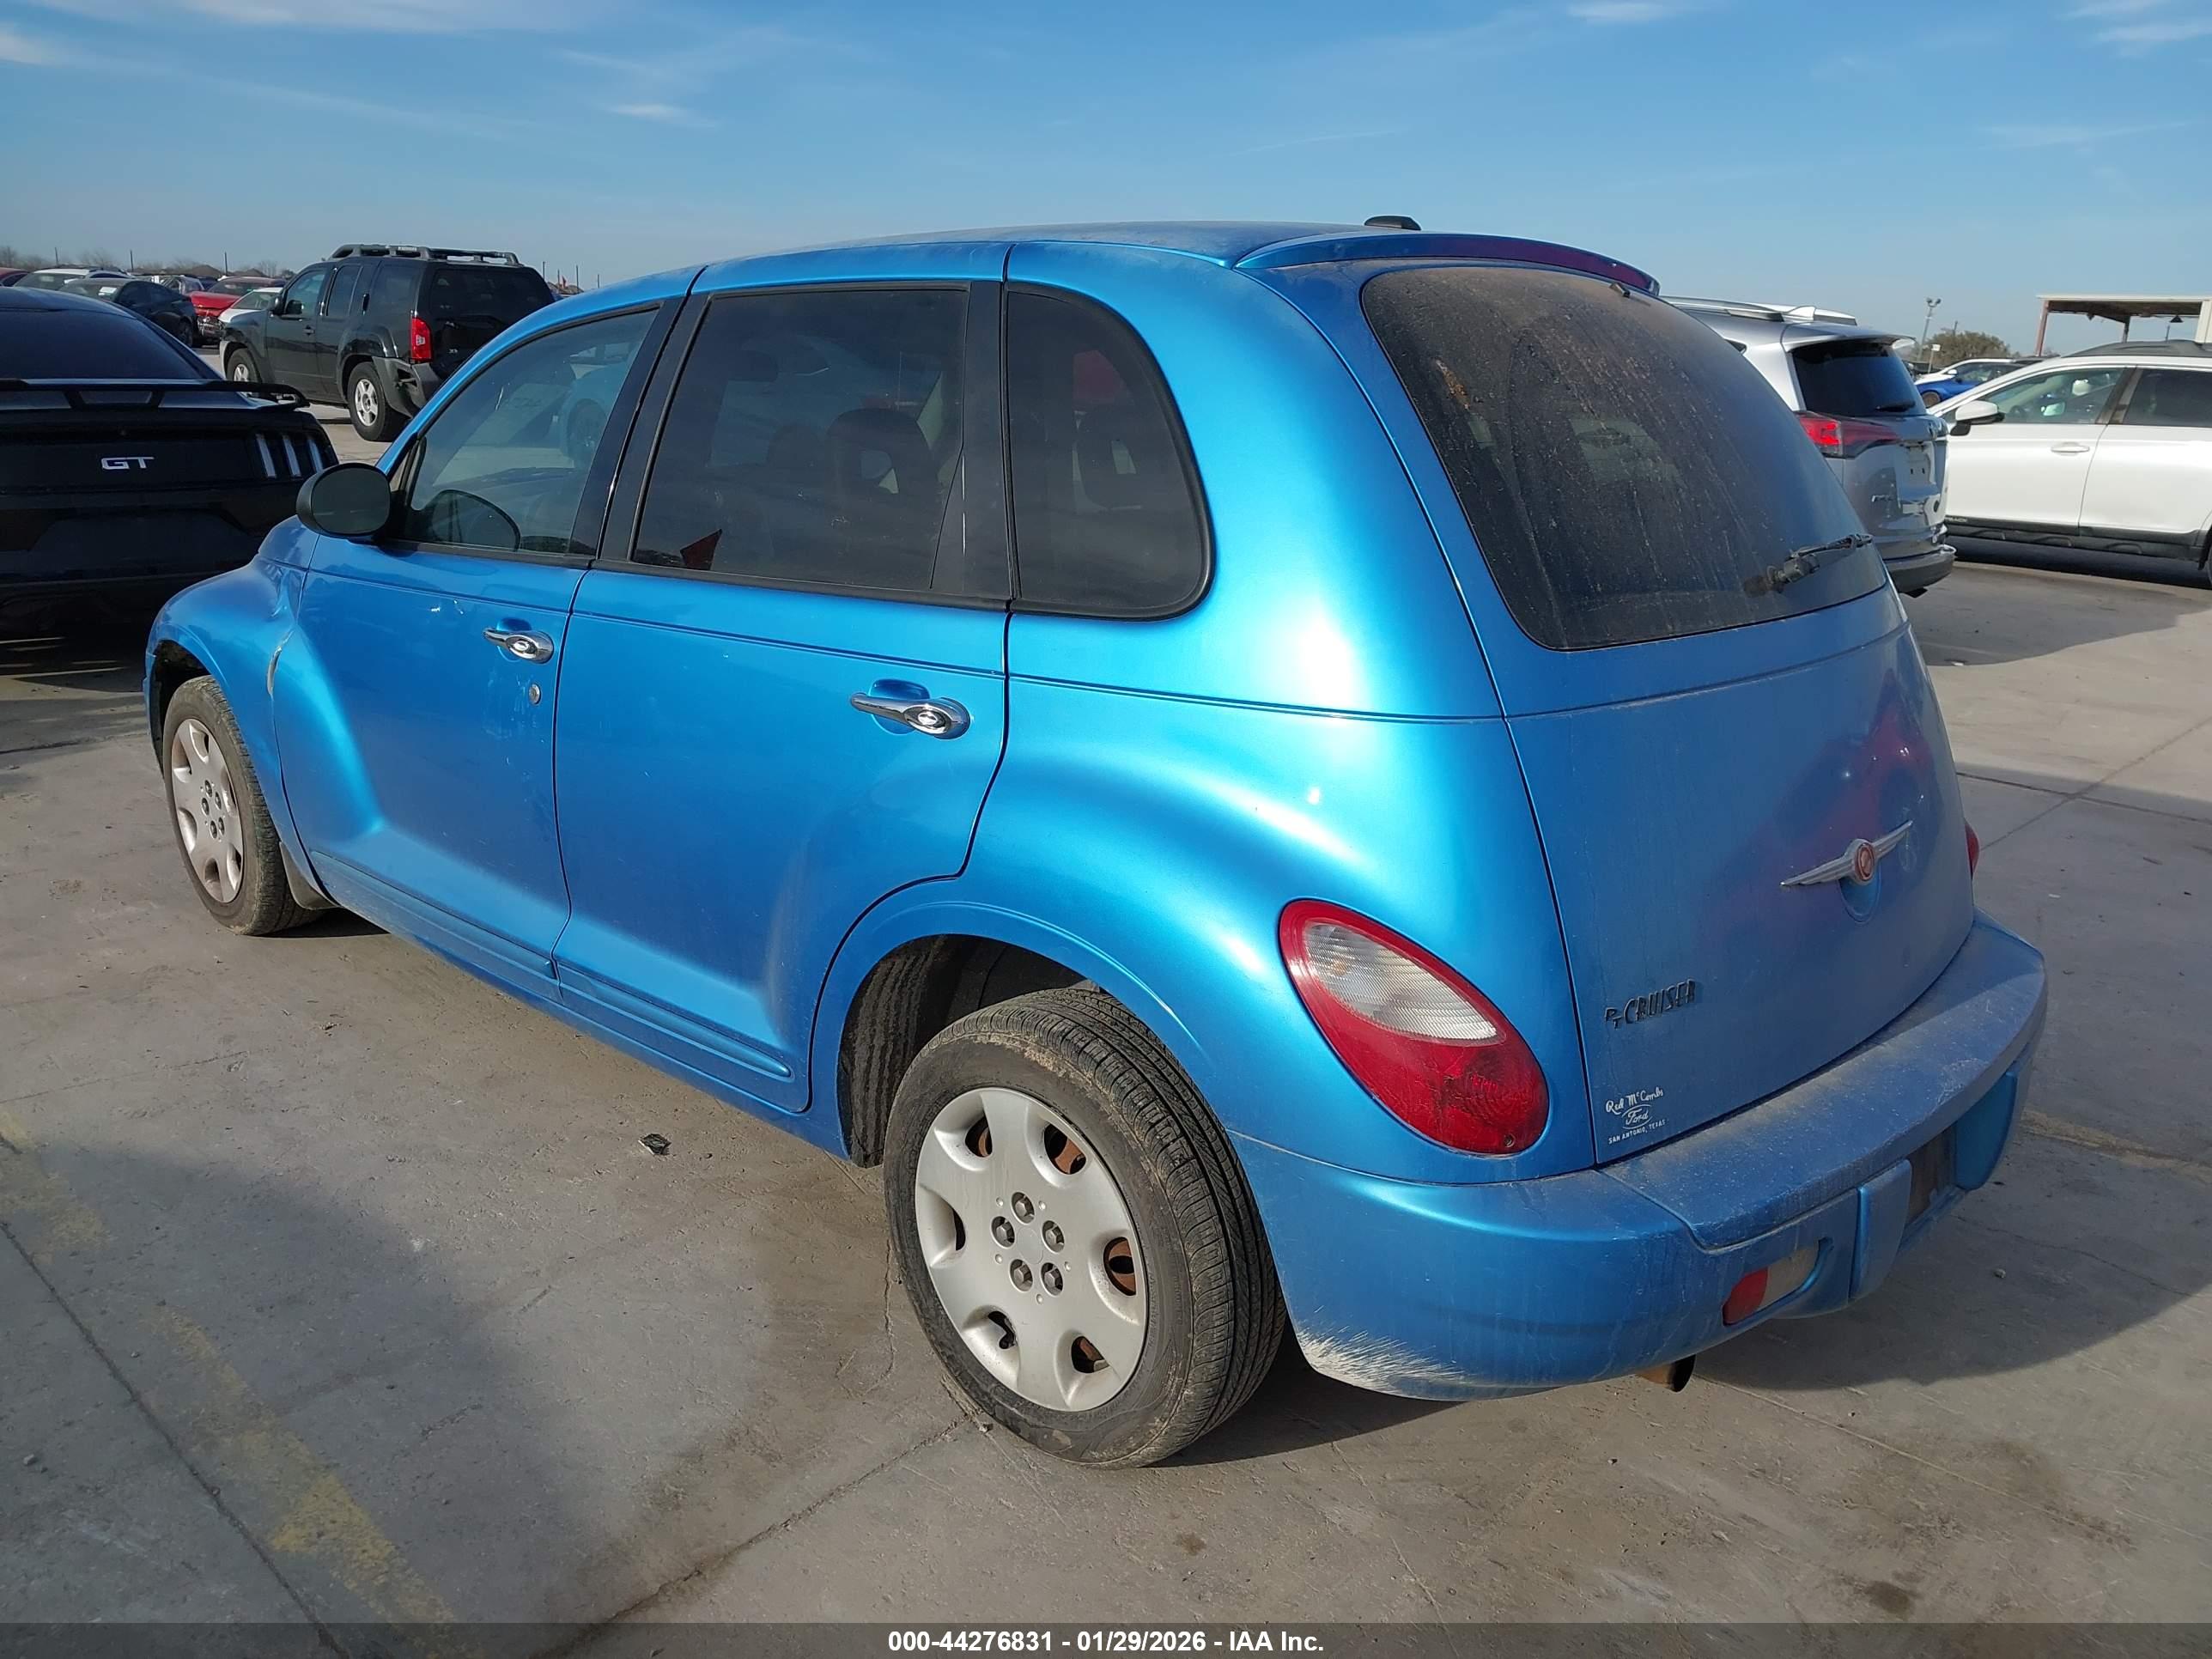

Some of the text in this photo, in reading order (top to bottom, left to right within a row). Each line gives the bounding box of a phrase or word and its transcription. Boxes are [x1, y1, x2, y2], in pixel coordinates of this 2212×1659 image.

[100, 456, 155, 470] GT
[1604, 977, 1697, 1030] PT CRUISER
[1605, 1086, 1664, 1115] Red McCombs
[1626, 1107, 1649, 1126] Ford
[1607, 1133, 1621, 1145] SAN
[1649, 1119, 1666, 1130] TEXAS
